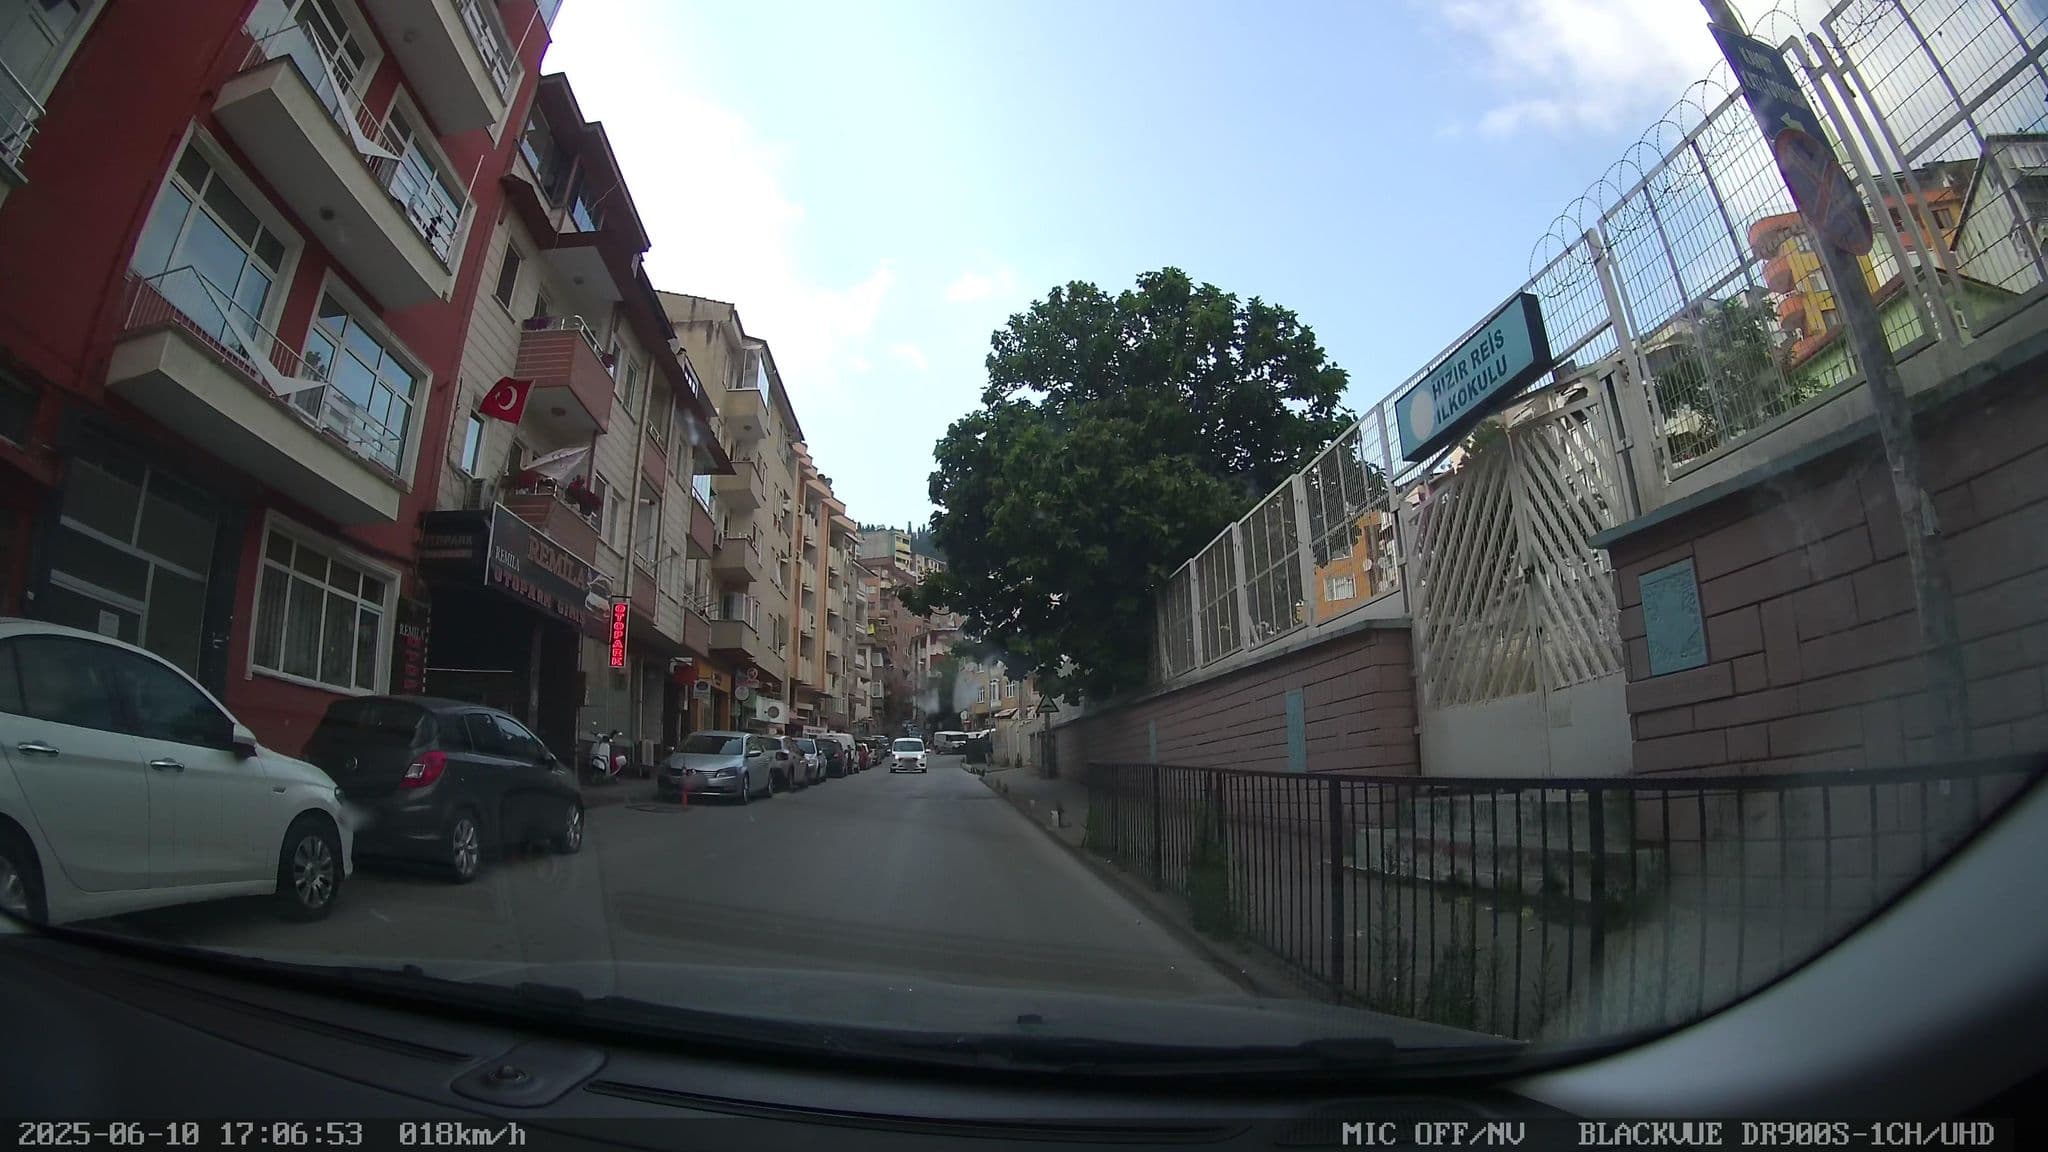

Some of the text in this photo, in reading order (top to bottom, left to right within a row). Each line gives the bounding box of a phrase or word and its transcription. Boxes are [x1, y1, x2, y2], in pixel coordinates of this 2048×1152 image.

[1431, 328, 1505, 402] HIZIR REİS
[1435, 354, 1508, 425] İLKOKULU
[611, 603, 628, 666] OTOPARK
